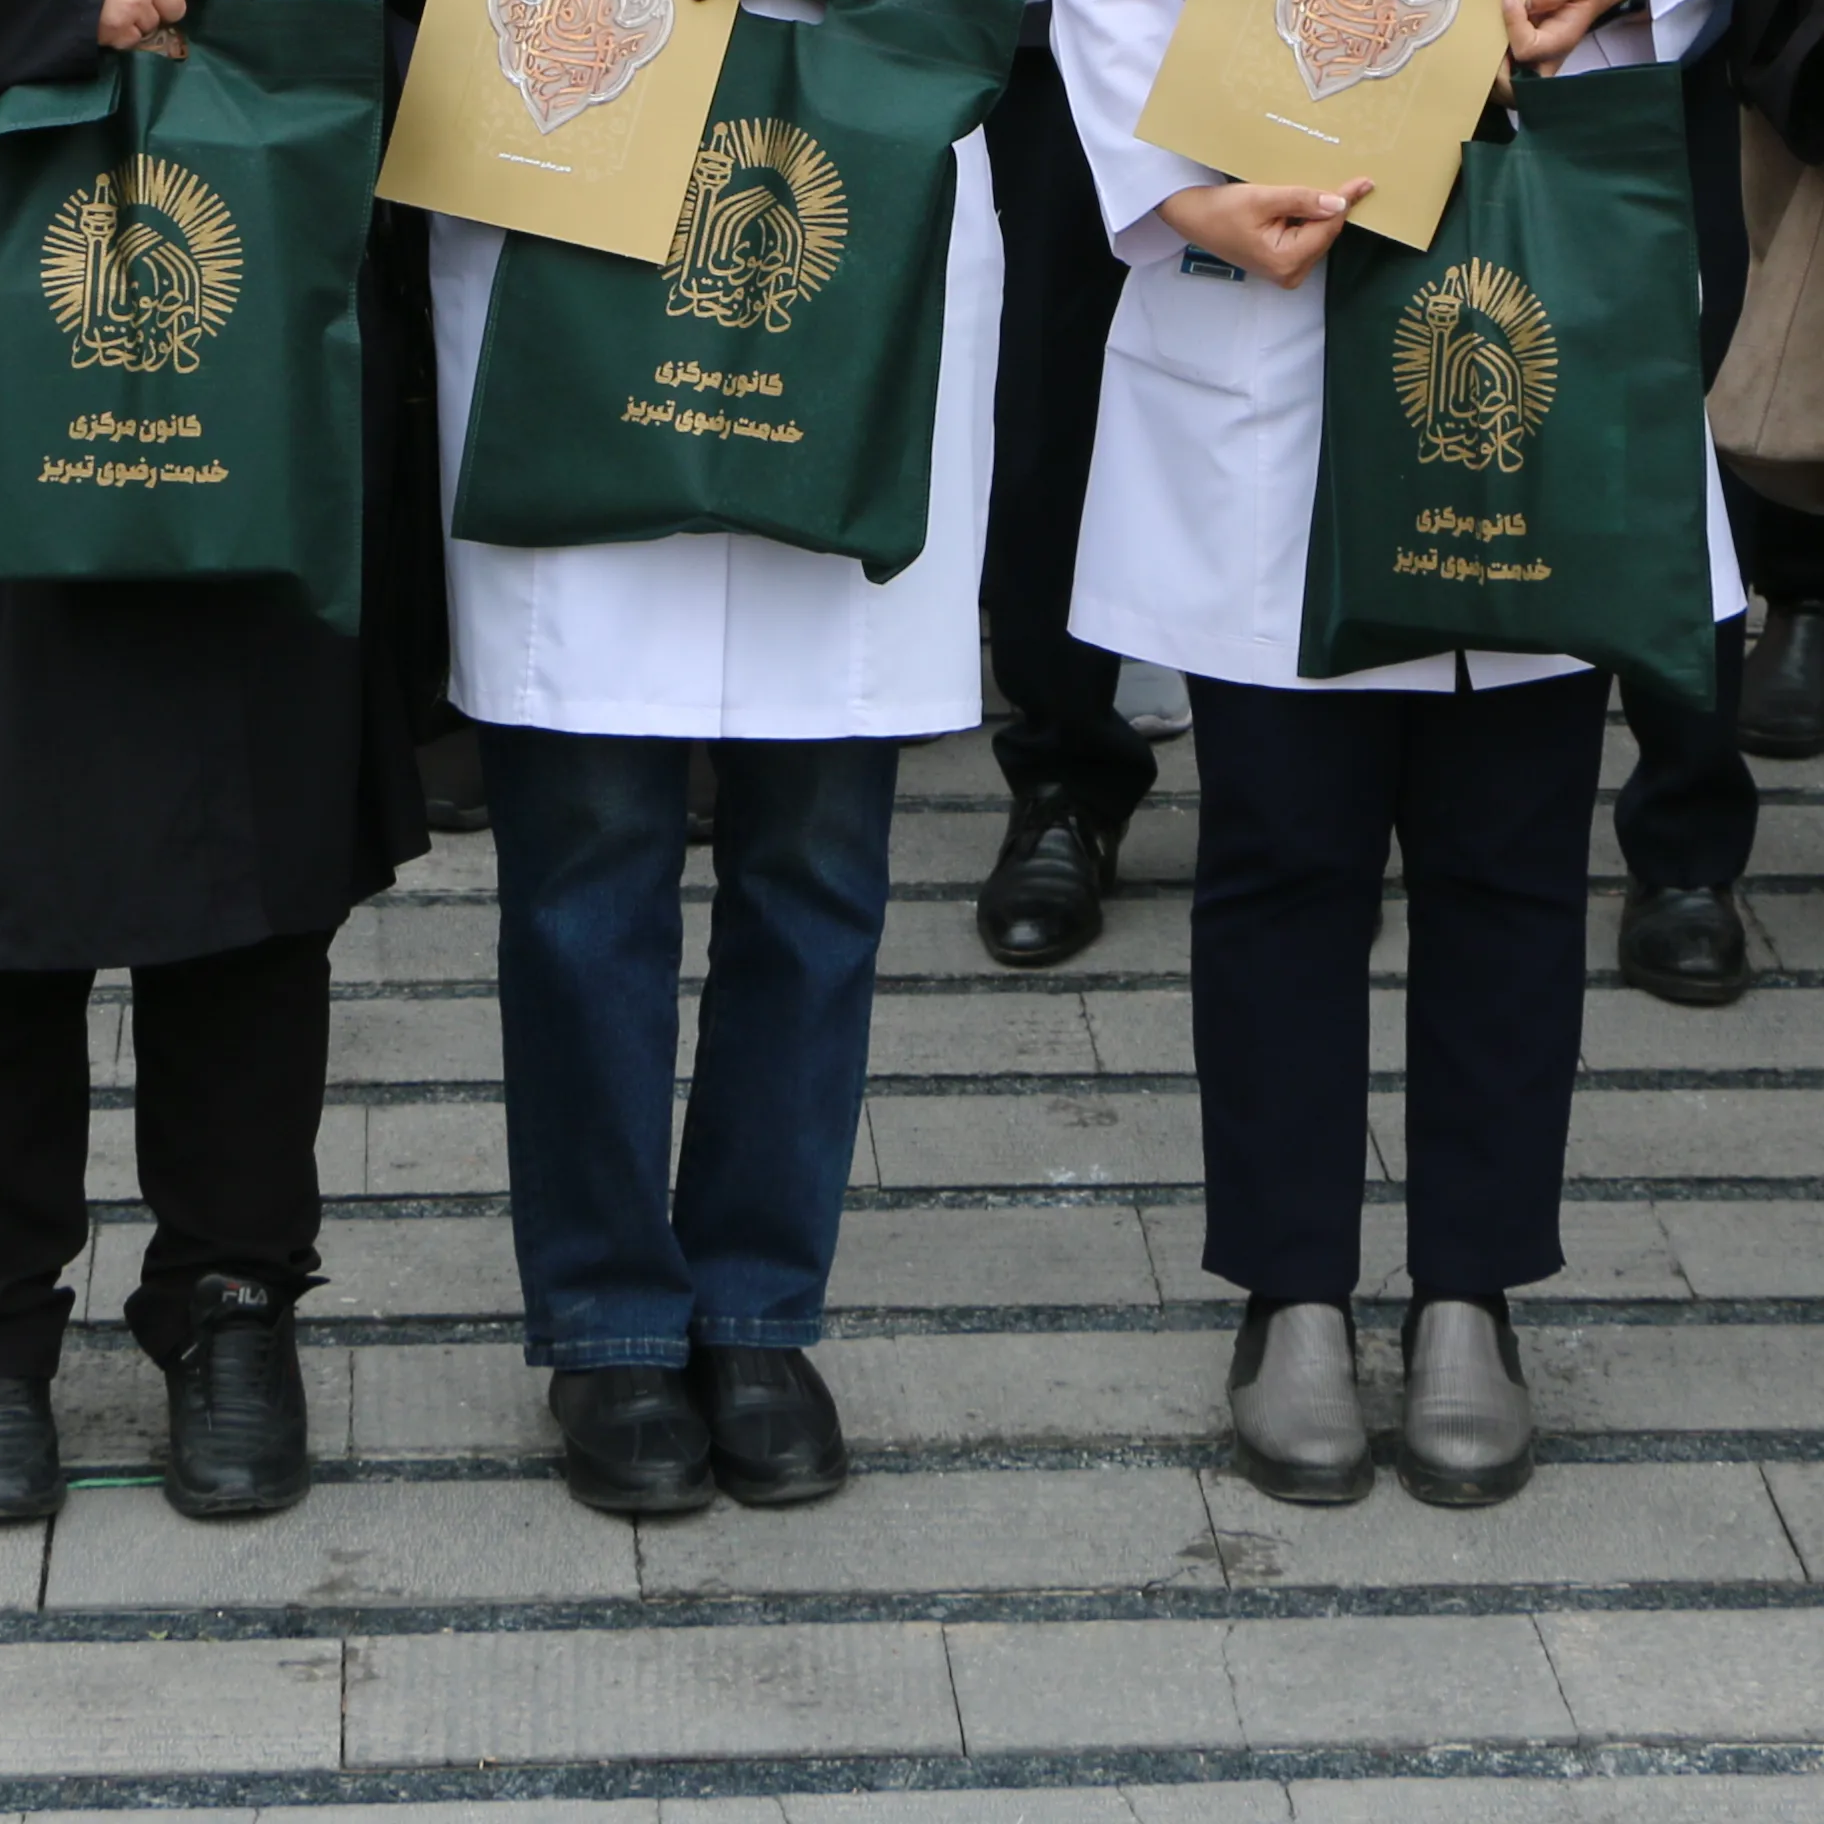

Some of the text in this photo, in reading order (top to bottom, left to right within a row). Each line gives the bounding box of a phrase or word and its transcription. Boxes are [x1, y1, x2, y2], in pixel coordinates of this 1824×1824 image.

[654, 360, 784, 398] کانون مرکزی
[68, 411, 202, 443] کانون مرکزی
[620, 395, 804, 443] خدمت رضوی تبریز
[37, 455, 229, 488] خدمت رضوی تبریز
[1416, 506, 1475, 537] مرکزی
[1393, 546, 1438, 575] تبریز
[1487, 557, 1552, 581] خدمت
[222, 1282, 268, 1304] FILA
